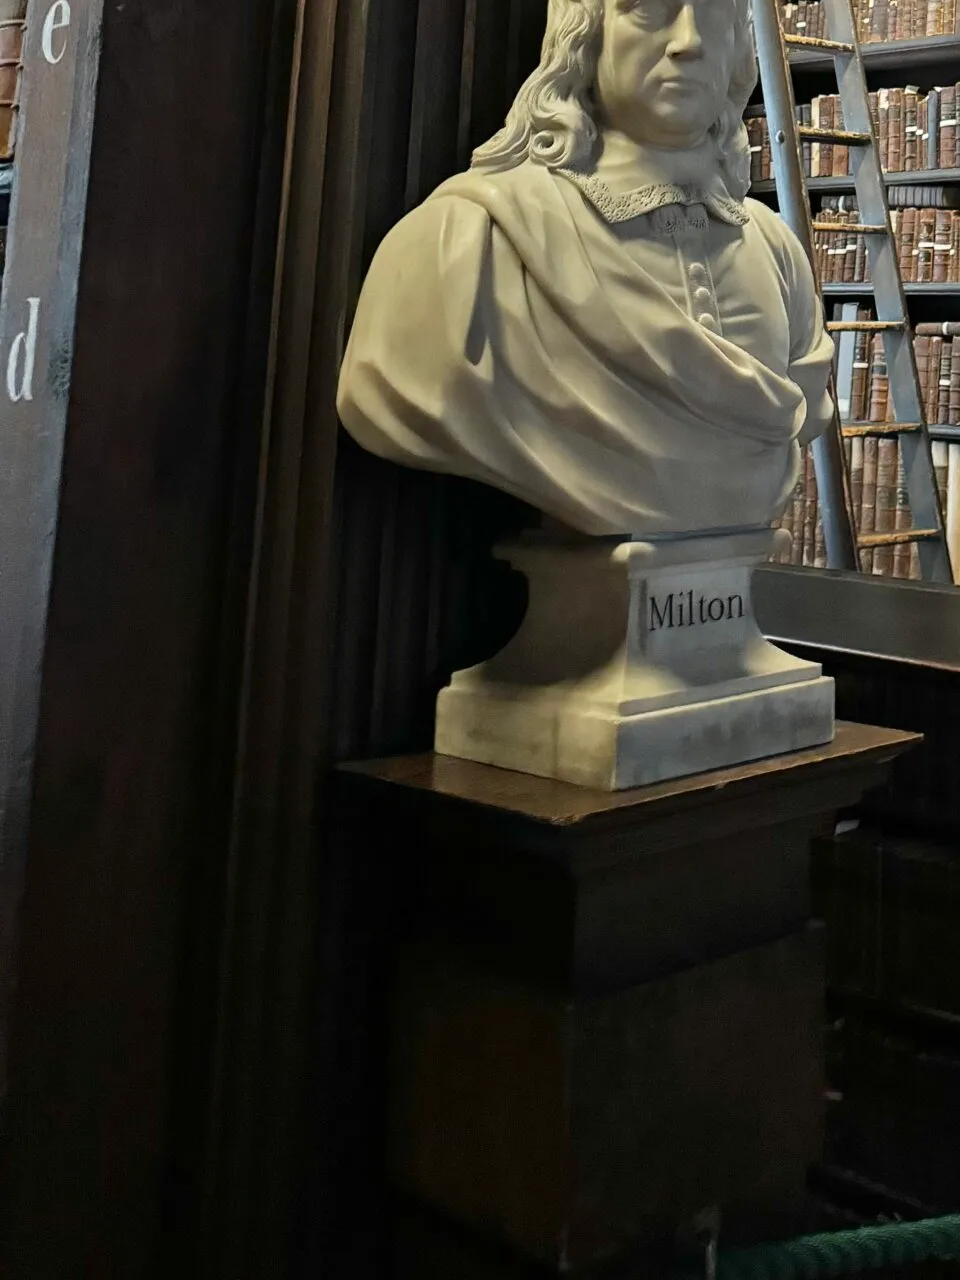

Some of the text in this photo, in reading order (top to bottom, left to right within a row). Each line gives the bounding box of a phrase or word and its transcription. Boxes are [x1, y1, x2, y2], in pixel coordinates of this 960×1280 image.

[42, 0, 70, 64] e
[6, 298, 40, 401] d
[649, 589, 745, 631] Milton
